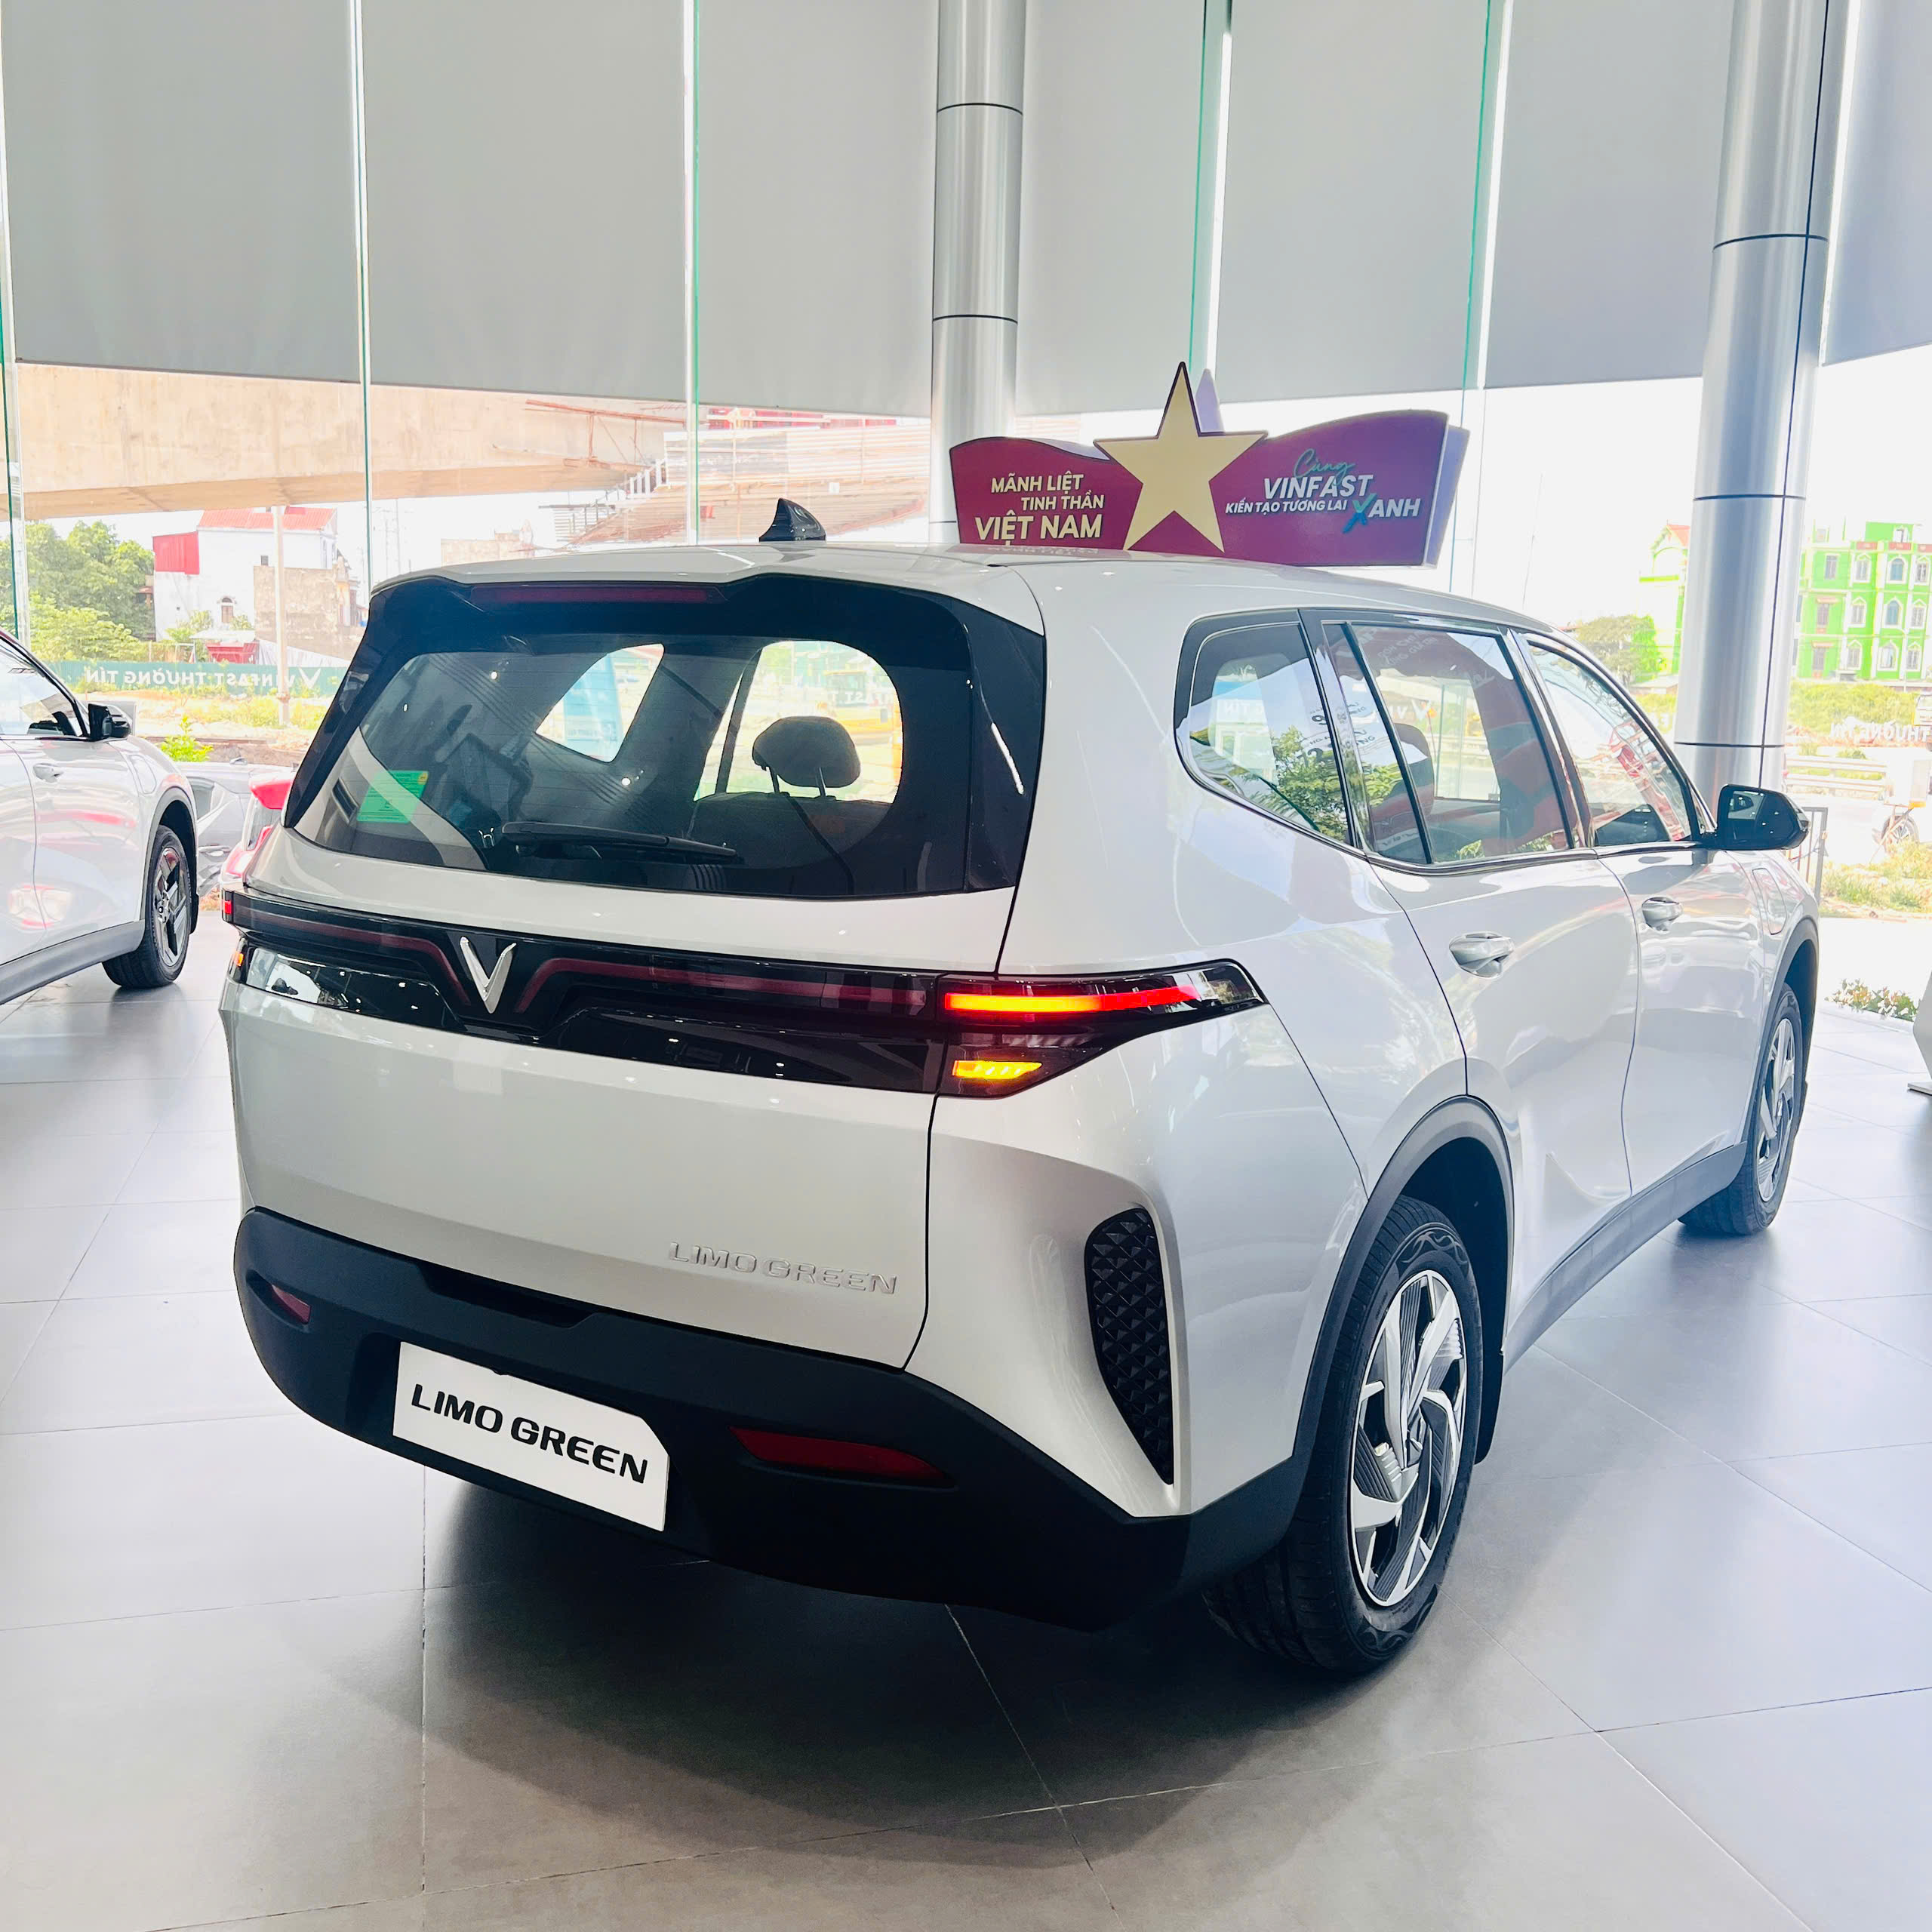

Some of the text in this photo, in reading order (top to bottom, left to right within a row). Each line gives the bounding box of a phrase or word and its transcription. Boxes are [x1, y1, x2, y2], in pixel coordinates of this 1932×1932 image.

[991, 470, 1084, 494] MÃNH LIỆT
[1263, 474, 1374, 500] VINFAST
[1021, 489, 1105, 511] TINH THẦN
[1225, 497, 1254, 514] KIẾN
[1255, 501, 1281, 515] TẠO
[1282, 499, 1326, 512] TƯƠNG
[1327, 499, 1348, 511] LAI
[974, 509, 1103, 546] VIỆT NAM
[669, 1241, 897, 1294] LIMO GREEN
[411, 1383, 648, 1484] LIMO GREEN
